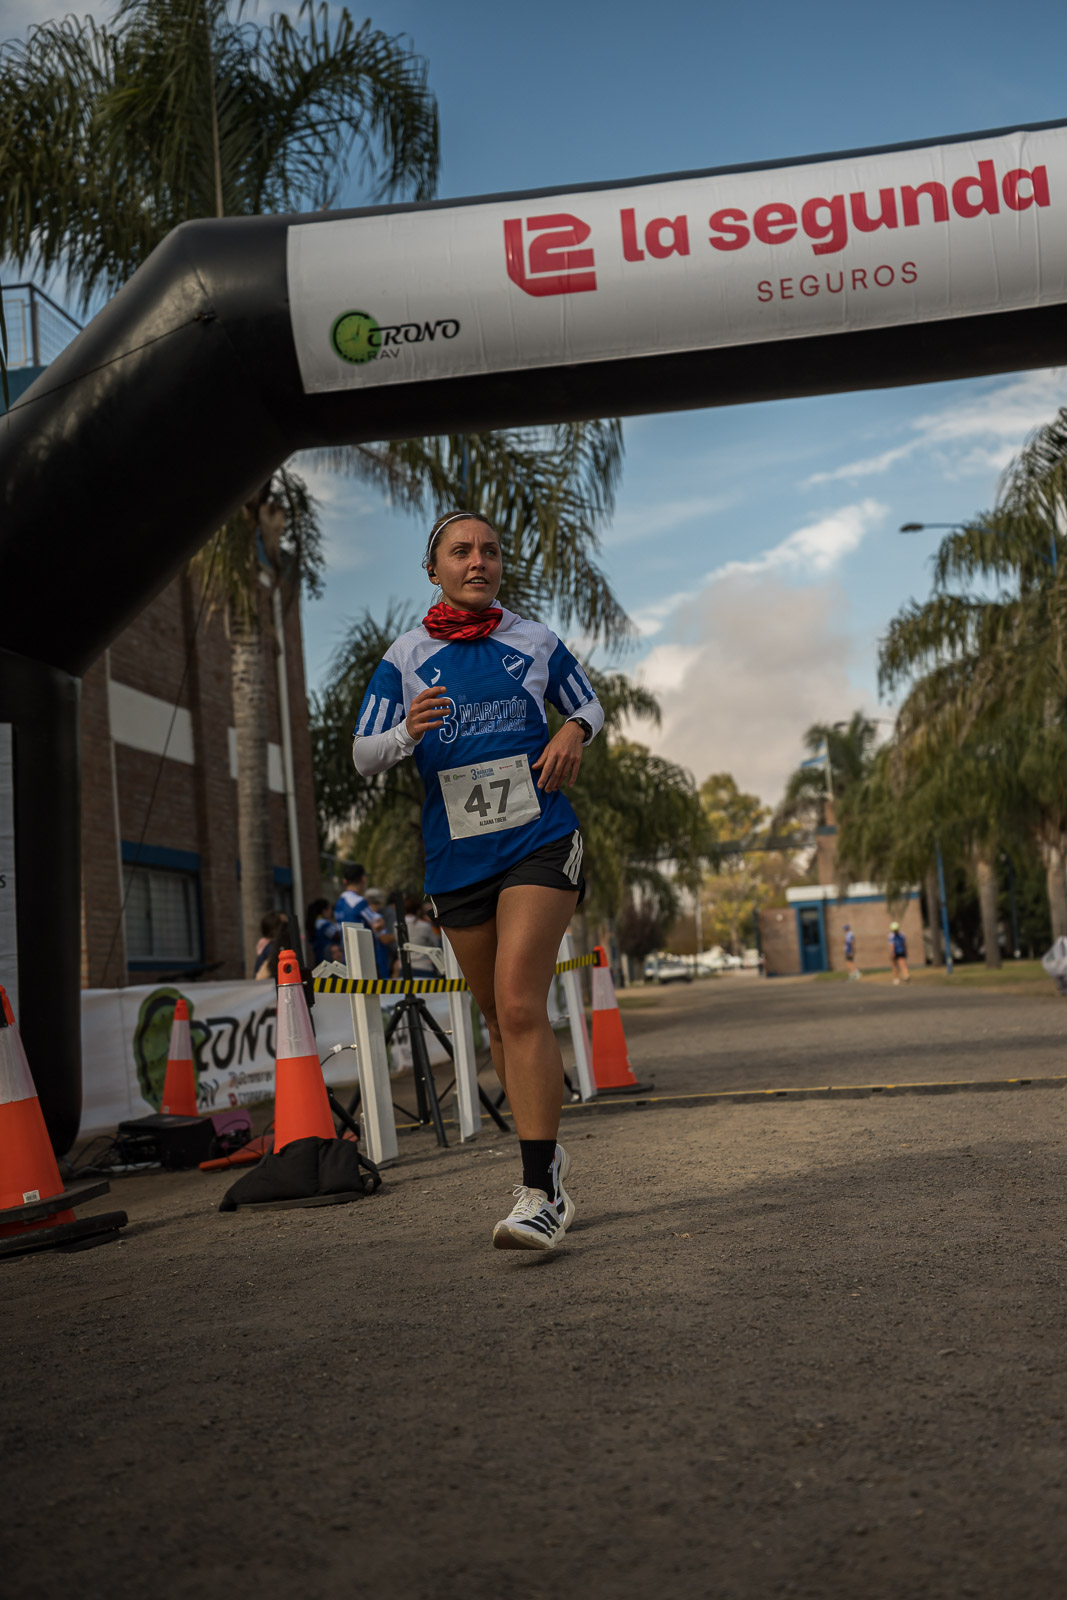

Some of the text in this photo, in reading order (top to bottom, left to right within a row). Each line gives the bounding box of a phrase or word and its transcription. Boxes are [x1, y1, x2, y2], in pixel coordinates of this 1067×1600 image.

[619, 159, 1052, 263] la segunda
[757, 261, 919, 303] SEGUROS
[367, 319, 460, 348] CRONO
[367, 348, 400, 360] RAV
[439, 695, 527, 744] 3 MARATÓN
[464, 778, 511, 818] 47
